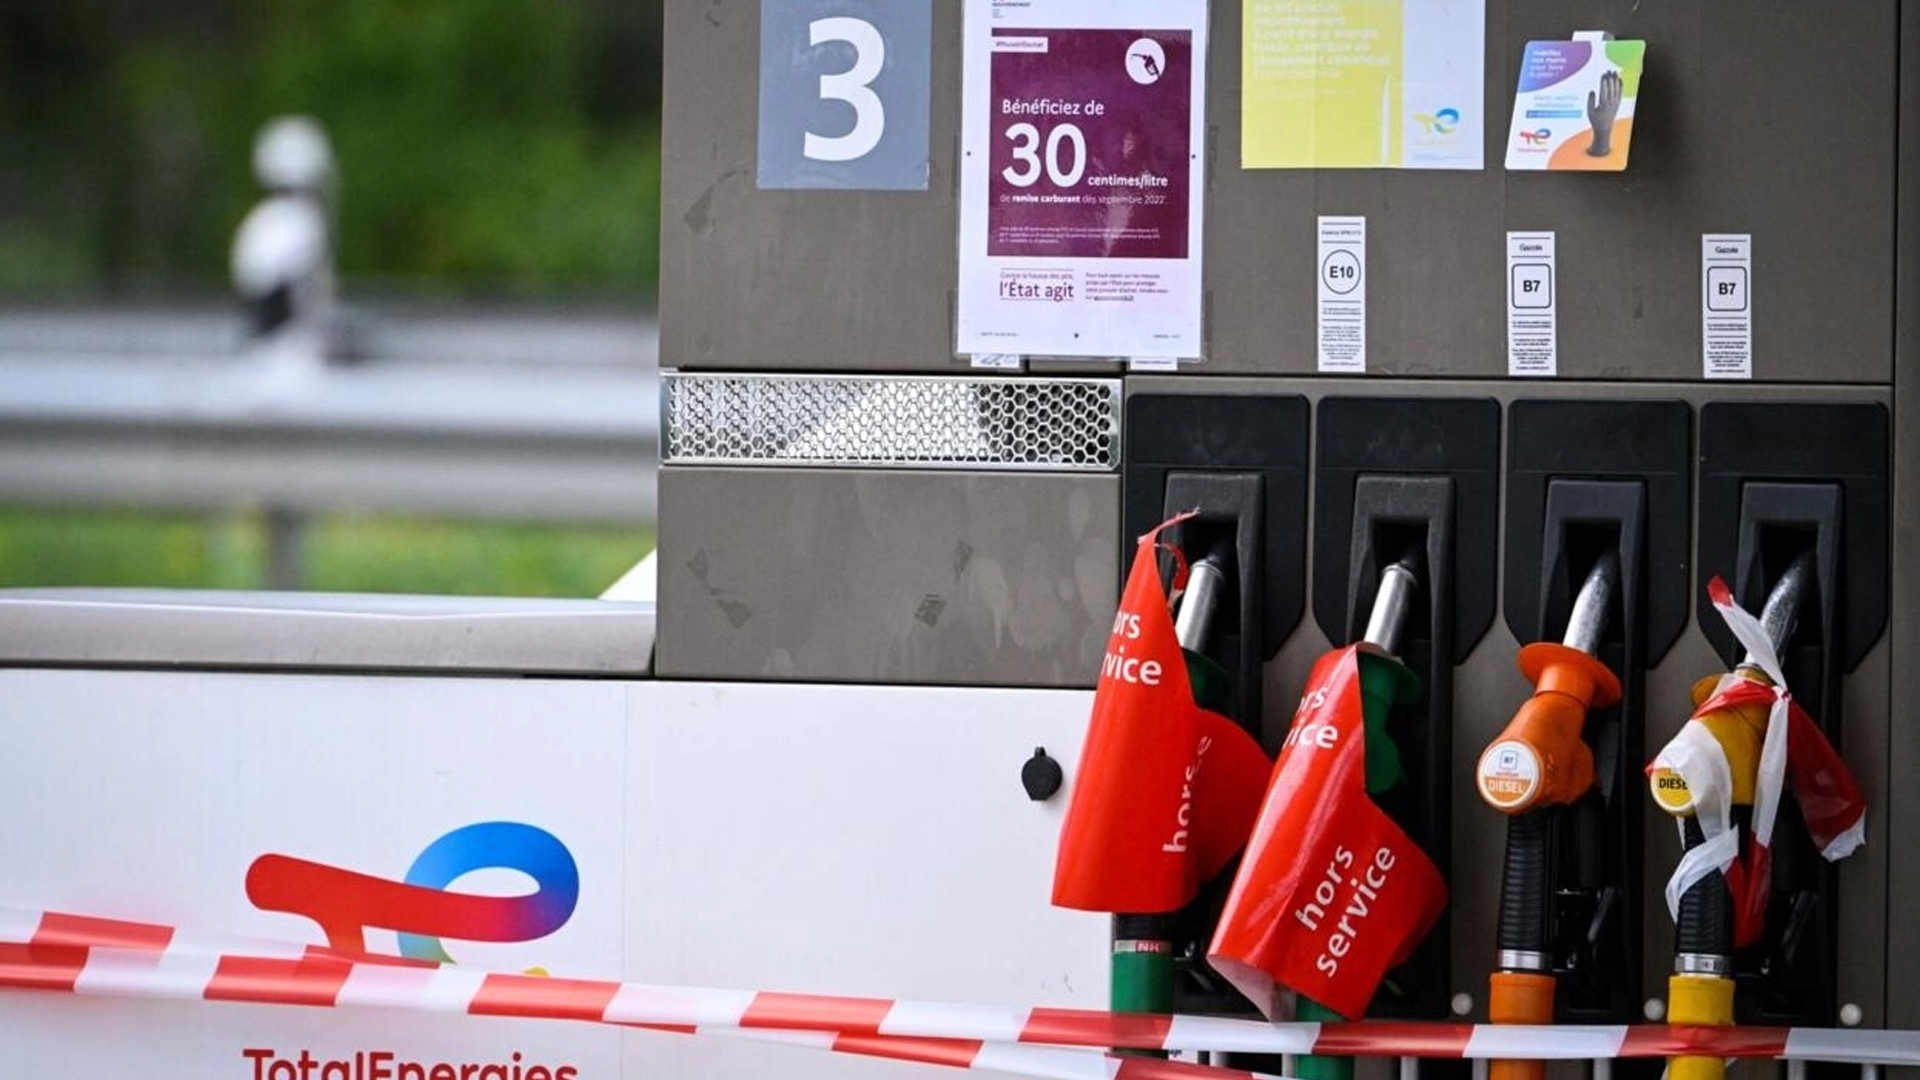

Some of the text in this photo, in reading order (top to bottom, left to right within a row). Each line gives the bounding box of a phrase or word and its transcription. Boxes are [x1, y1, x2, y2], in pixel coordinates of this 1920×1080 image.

[803, 16, 885, 161] 3
[1002, 98, 1105, 115] Bénéficiez de
[1002, 122, 1087, 188] 30
[1088, 173, 1169, 189] centimes/litre
[1012, 193, 1039, 203] remise
[1041, 193, 1080, 203] carburant
[1329, 266, 1354, 279] E10
[1000, 279, 1074, 302] l'État agit
[1523, 280, 1541, 292] B7
[1718, 282, 1737, 295] B7
[1113, 610, 1141, 639] ors
[1486, 778, 1525, 794] DIESEL
[1658, 777, 1688, 790] DIESE
[1295, 845, 1353, 931] hors
[1316, 847, 1396, 979] service
